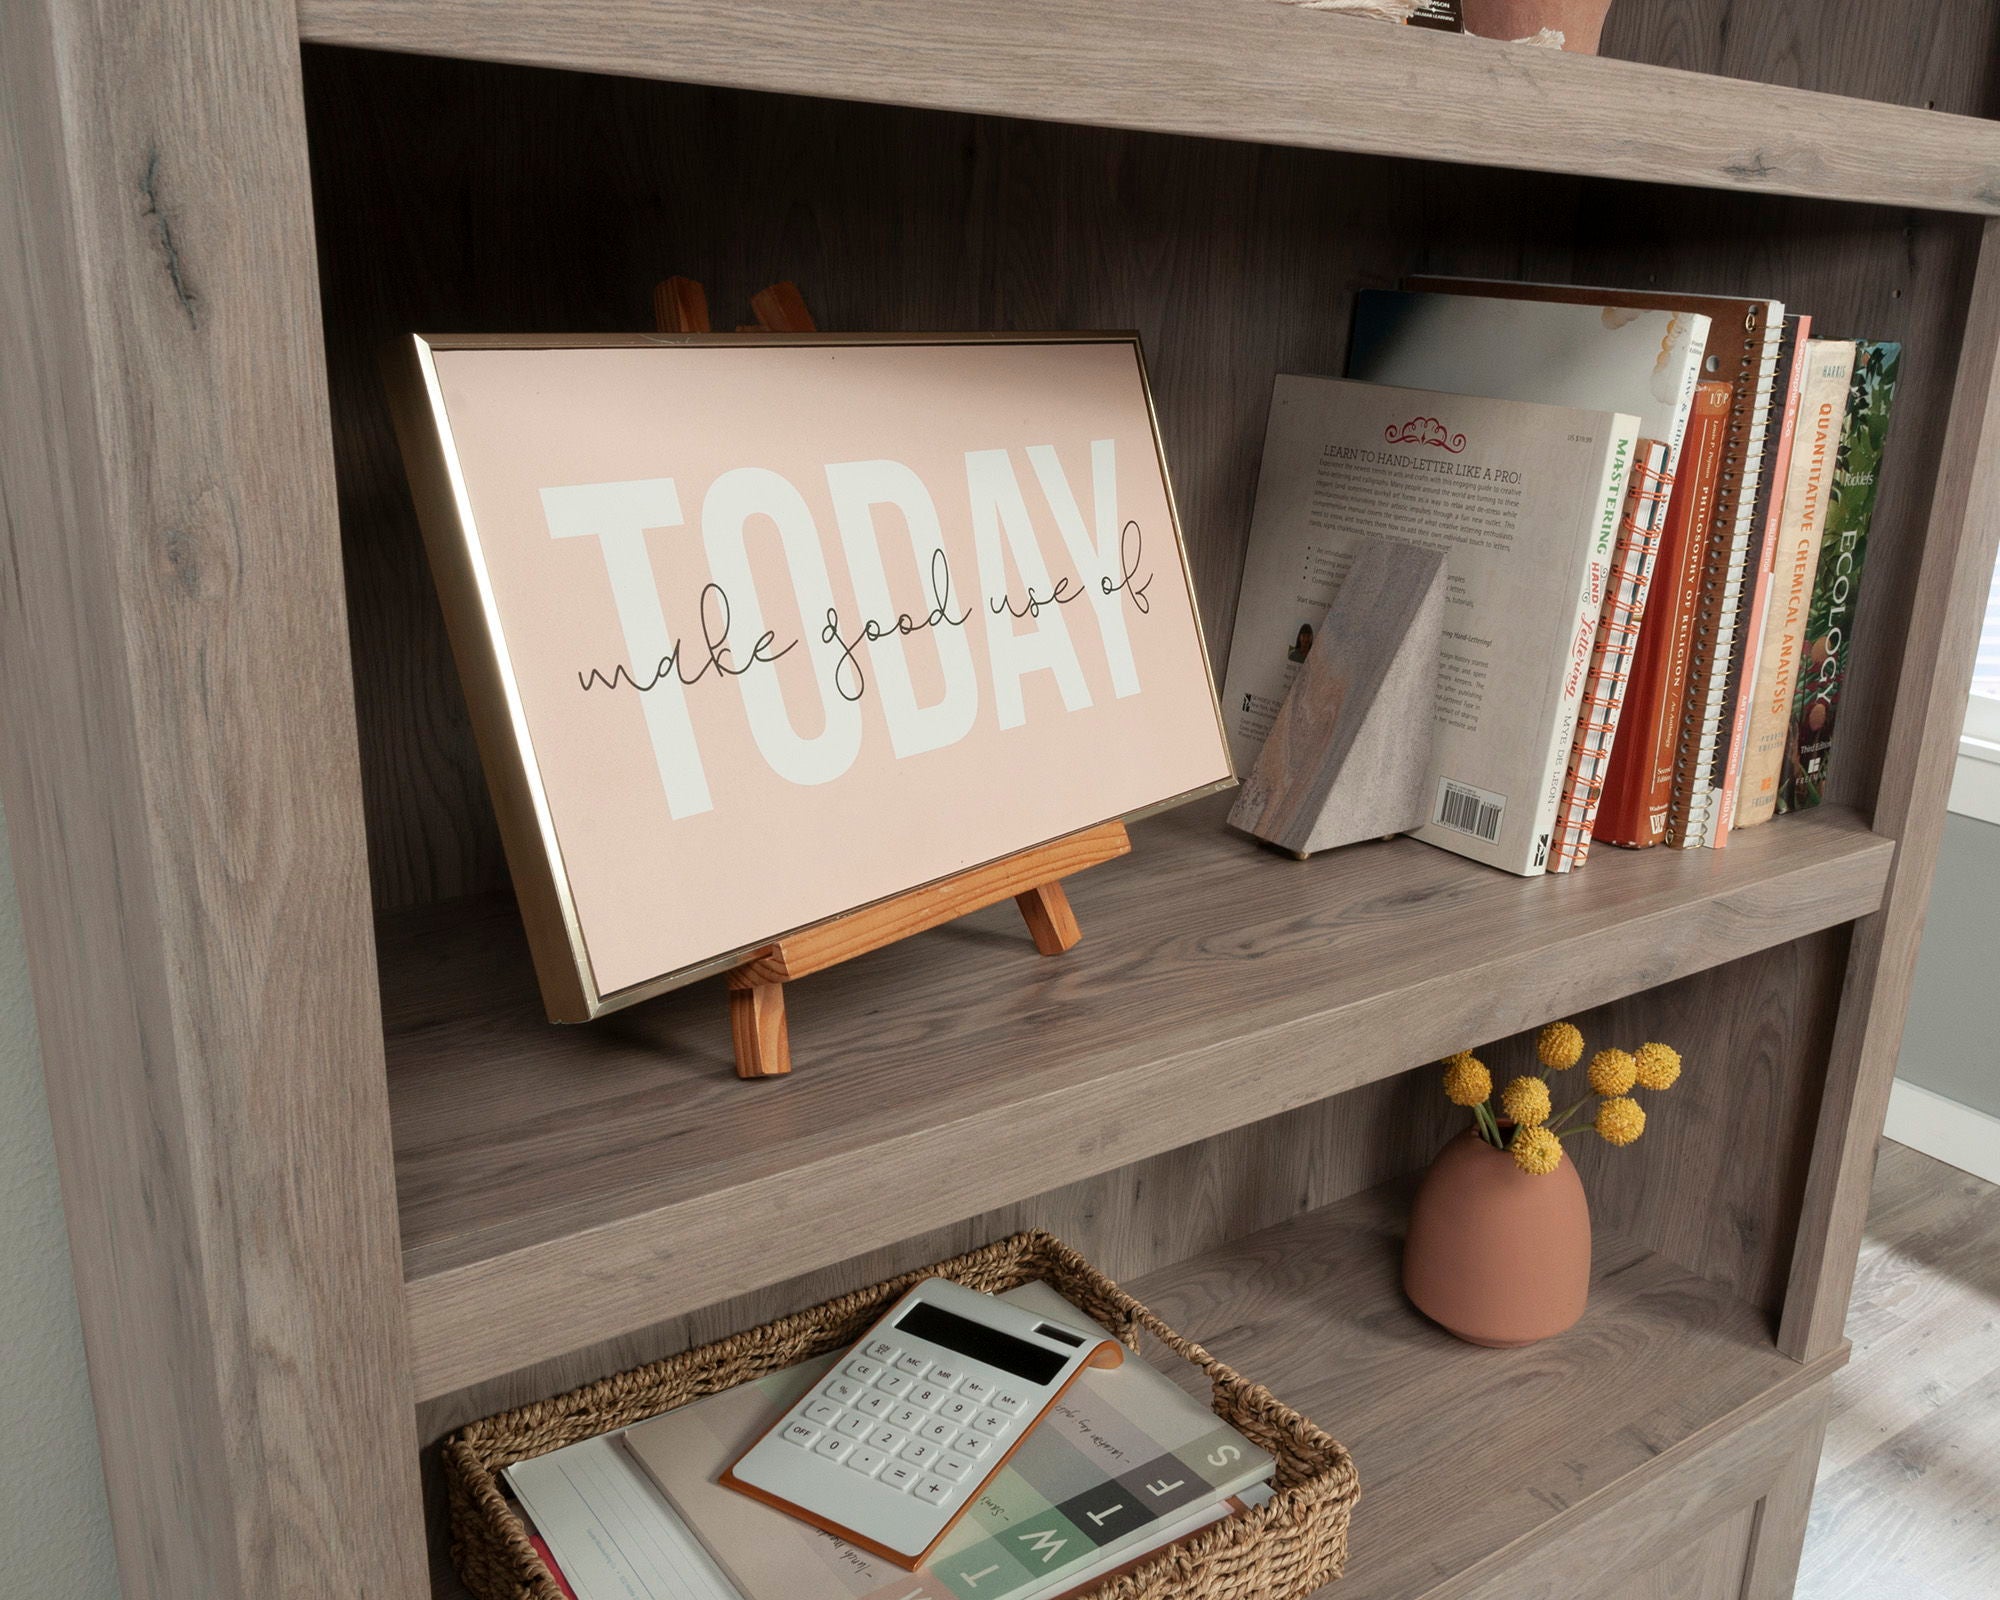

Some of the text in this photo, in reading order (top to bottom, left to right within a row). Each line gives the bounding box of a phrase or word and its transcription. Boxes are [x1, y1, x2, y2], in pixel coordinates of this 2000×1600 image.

[1822, 365, 1846, 378] HARRIS
[1684, 366, 1696, 396] Law
[1680, 402, 1688, 413] &
[1670, 419, 1684, 463] Ethics
[1323, 443, 1522, 485] LEARN TO HAND-LETTER LIKE A PRO!
[1844, 472, 1874, 486] Ricklefs
[1688, 486, 1709, 583] PHILOSOPHY
[1772, 403, 1832, 714] QUANTITATIVE CHEMICAL ANALYSIS
[1684, 590, 1692, 608] OF
[578, 520, 1154, 701] make good use of
[1817, 530, 1857, 703] ECOLOGY
[1547, 438, 1629, 804] MASTERING HAND Lettering MYE DE LEON
[538, 438, 1141, 820] TODAY
[1674, 615, 1689, 686] RELIGION
[1730, 734, 1741, 775] WONDERS
[1801, 744, 1815, 754] Third
[907, 1358, 921, 1367] MC
[858, 1366, 869, 1374] CE
[937, 1370, 952, 1379] MR
[890, 1378, 900, 1386] 7
[871, 1399, 880, 1407] 4
[922, 1392, 931, 1400] 8
[954, 1404, 963, 1413] 9
[902, 1412, 912, 1420] 5
[851, 1420, 859, 1428] 1
[935, 1425, 944, 1434] 6
[794, 1426, 812, 1437] OFF
[882, 1433, 892, 1443] 2
[830, 1441, 839, 1450] 0
[915, 1447, 925, 1456] 3
[1207, 1444, 1241, 1466] S
[1146, 1478, 1184, 1497] F
[1086, 1503, 1123, 1527] T
[1018, 1527, 1068, 1564] W
[960, 1564, 1000, 1588] T
